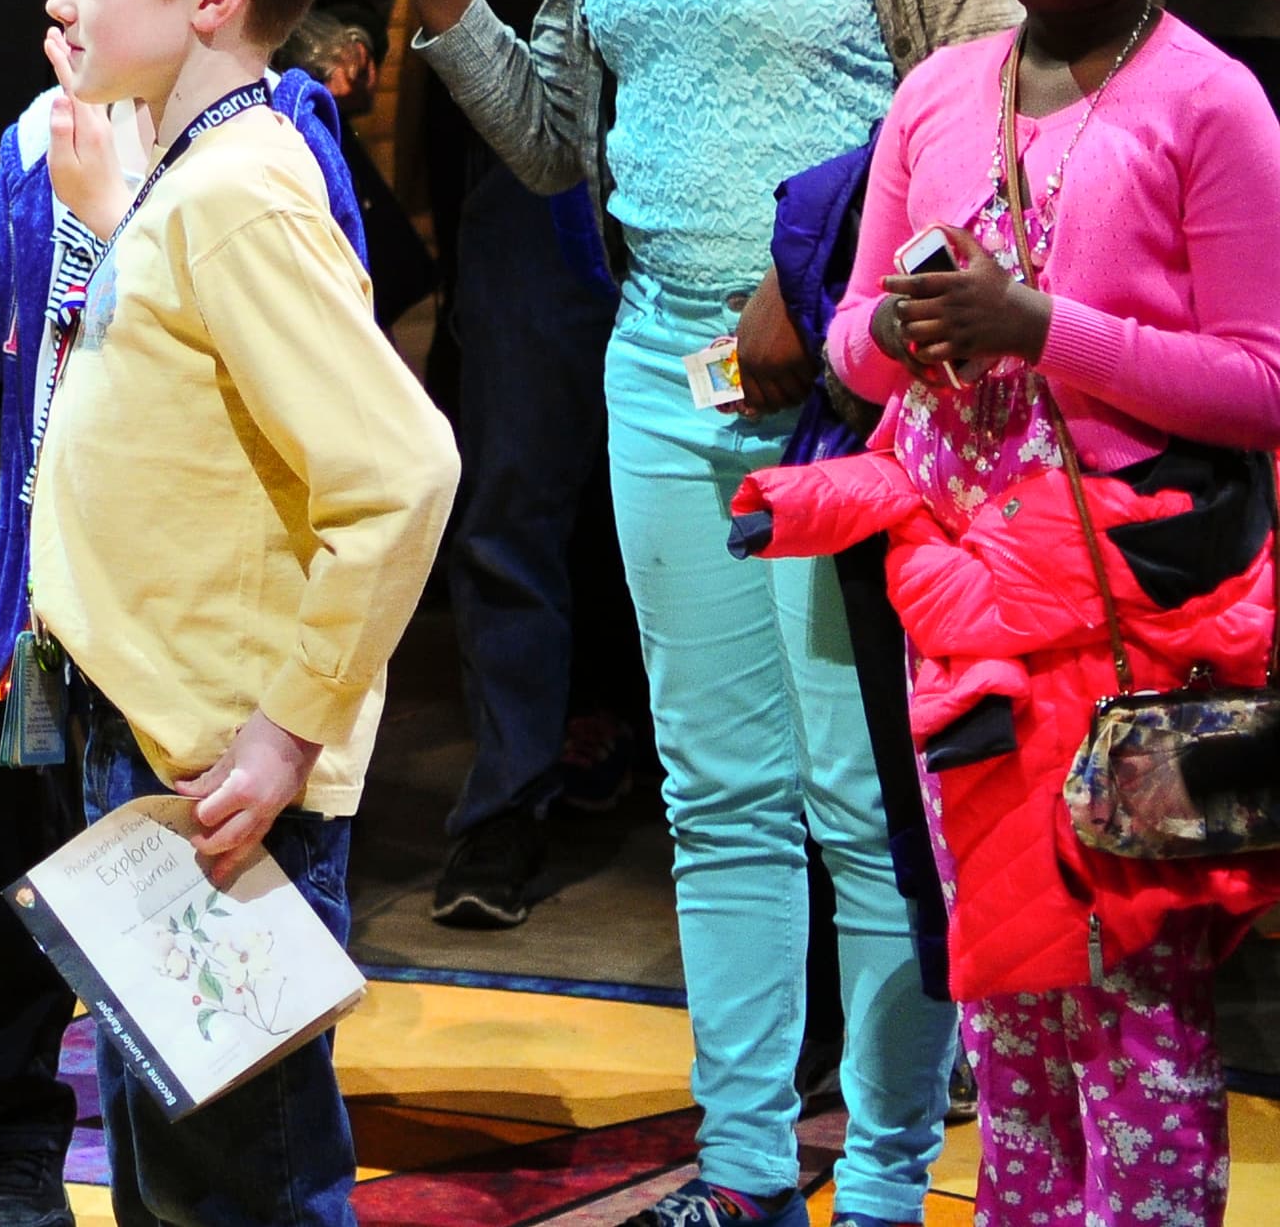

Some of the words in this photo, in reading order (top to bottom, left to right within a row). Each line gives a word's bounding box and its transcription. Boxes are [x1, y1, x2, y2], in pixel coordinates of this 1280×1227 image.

[96, 821, 178, 886] Explorer's
[129, 852, 179, 897] Journal
[96, 1000, 123, 1034] Ranger
[120, 1033, 145, 1062] Junior
[142, 1060, 150, 1069] a
[147, 1068, 177, 1106] Become
